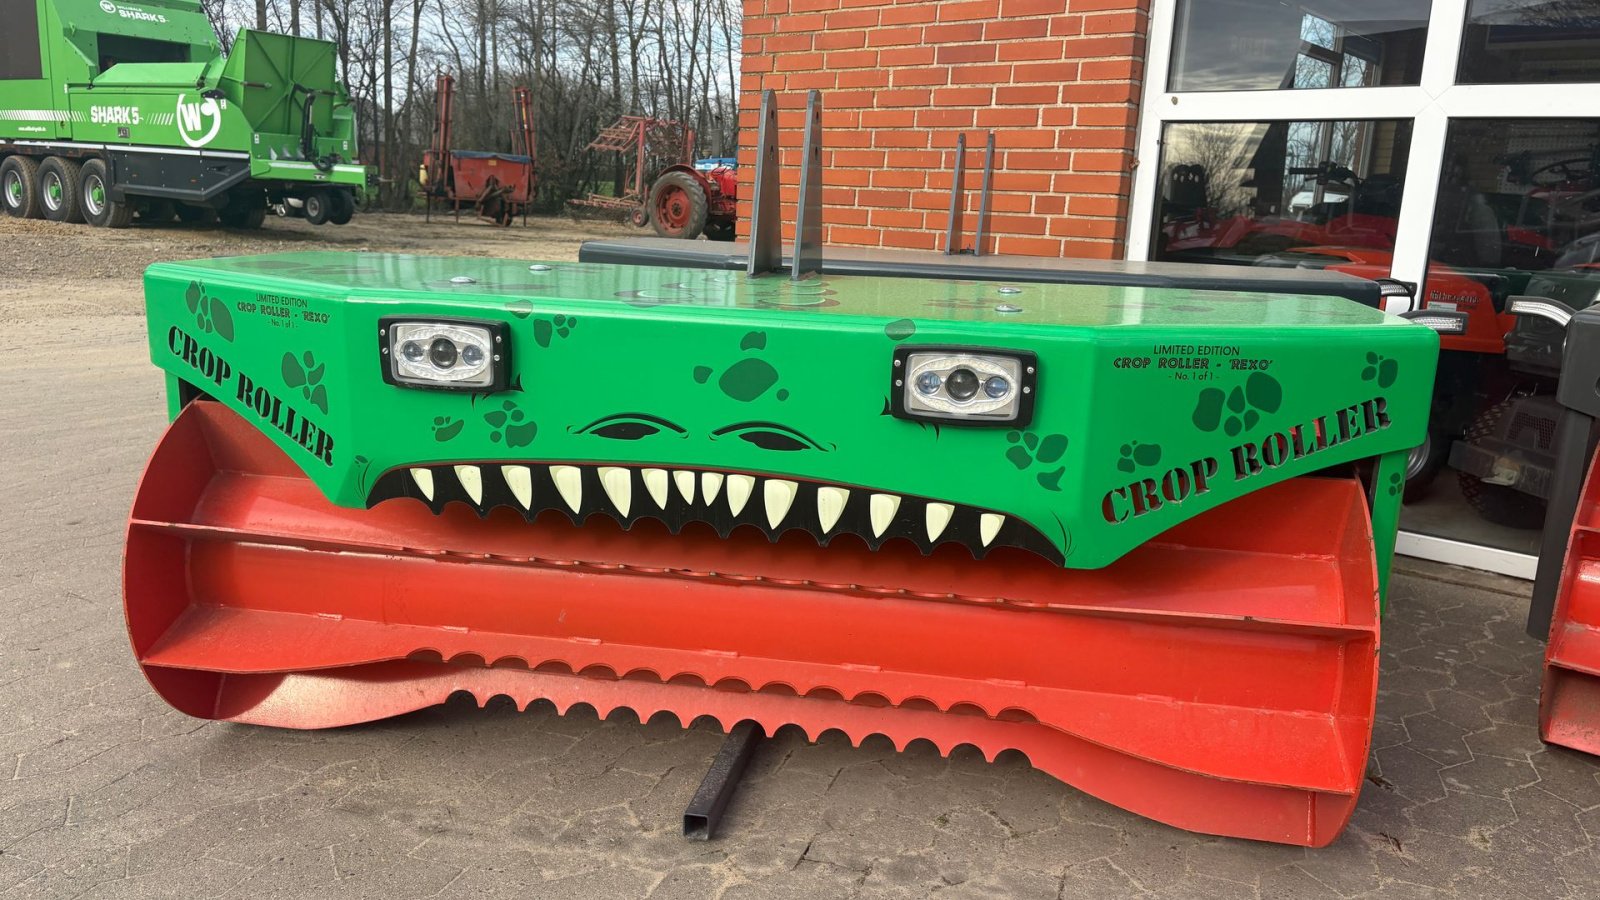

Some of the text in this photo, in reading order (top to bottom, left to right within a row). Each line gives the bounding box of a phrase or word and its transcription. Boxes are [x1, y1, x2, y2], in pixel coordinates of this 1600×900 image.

[119, 9, 167, 23] SHARK 5
[90, 105, 140, 125] SHARK 5
[256, 292, 308, 308] LIMITED EDITION
[237, 301, 257, 313] CROP
[260, 304, 291, 318] ROLLER
[1153, 344, 1240, 356] LIMITED EDITION
[1113, 357, 1151, 369] CROP
[1158, 357, 1210, 370] ROLLER
[1174, 372, 1190, 381] No.
[1198, 371, 1207, 381] of
[168, 325, 334, 467] CROP ROLLER
[1101, 396, 1393, 525] CROP ROLLER
